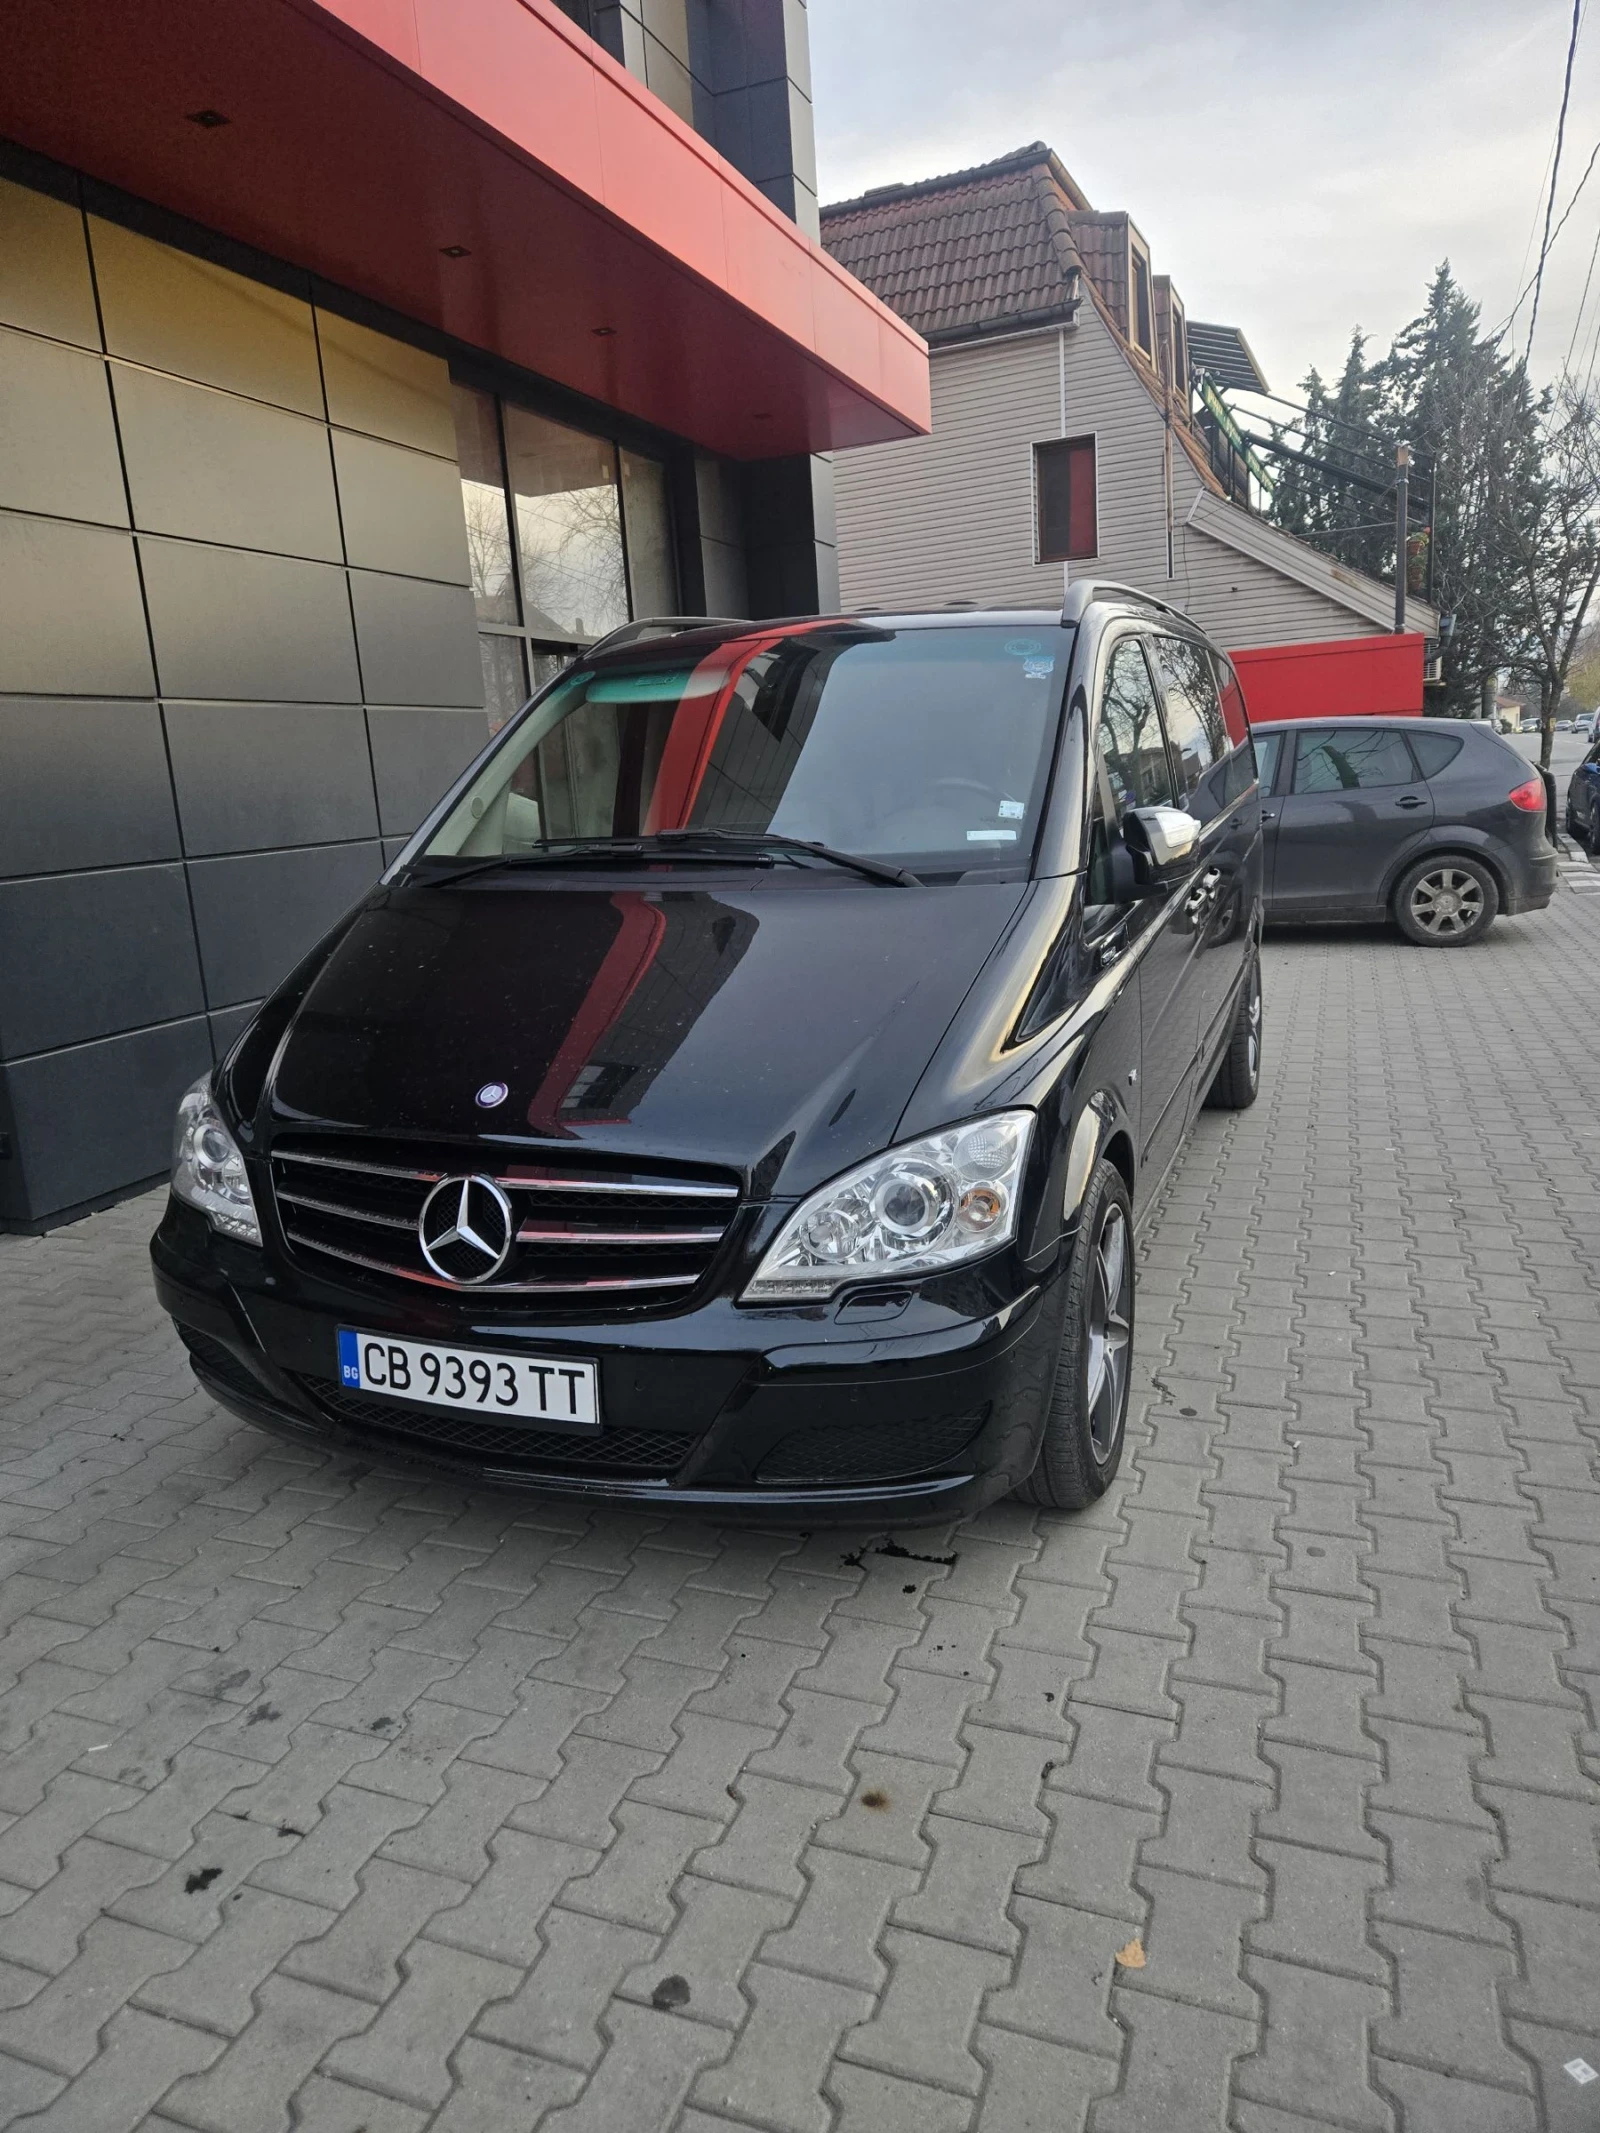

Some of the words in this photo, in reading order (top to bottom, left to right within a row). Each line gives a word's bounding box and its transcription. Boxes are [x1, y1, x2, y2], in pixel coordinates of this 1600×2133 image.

[343, 1365, 359, 1380] BG
[364, 1342, 411, 1391] CB
[419, 1352, 519, 1407] 9393
[528, 1365, 585, 1415] TT
